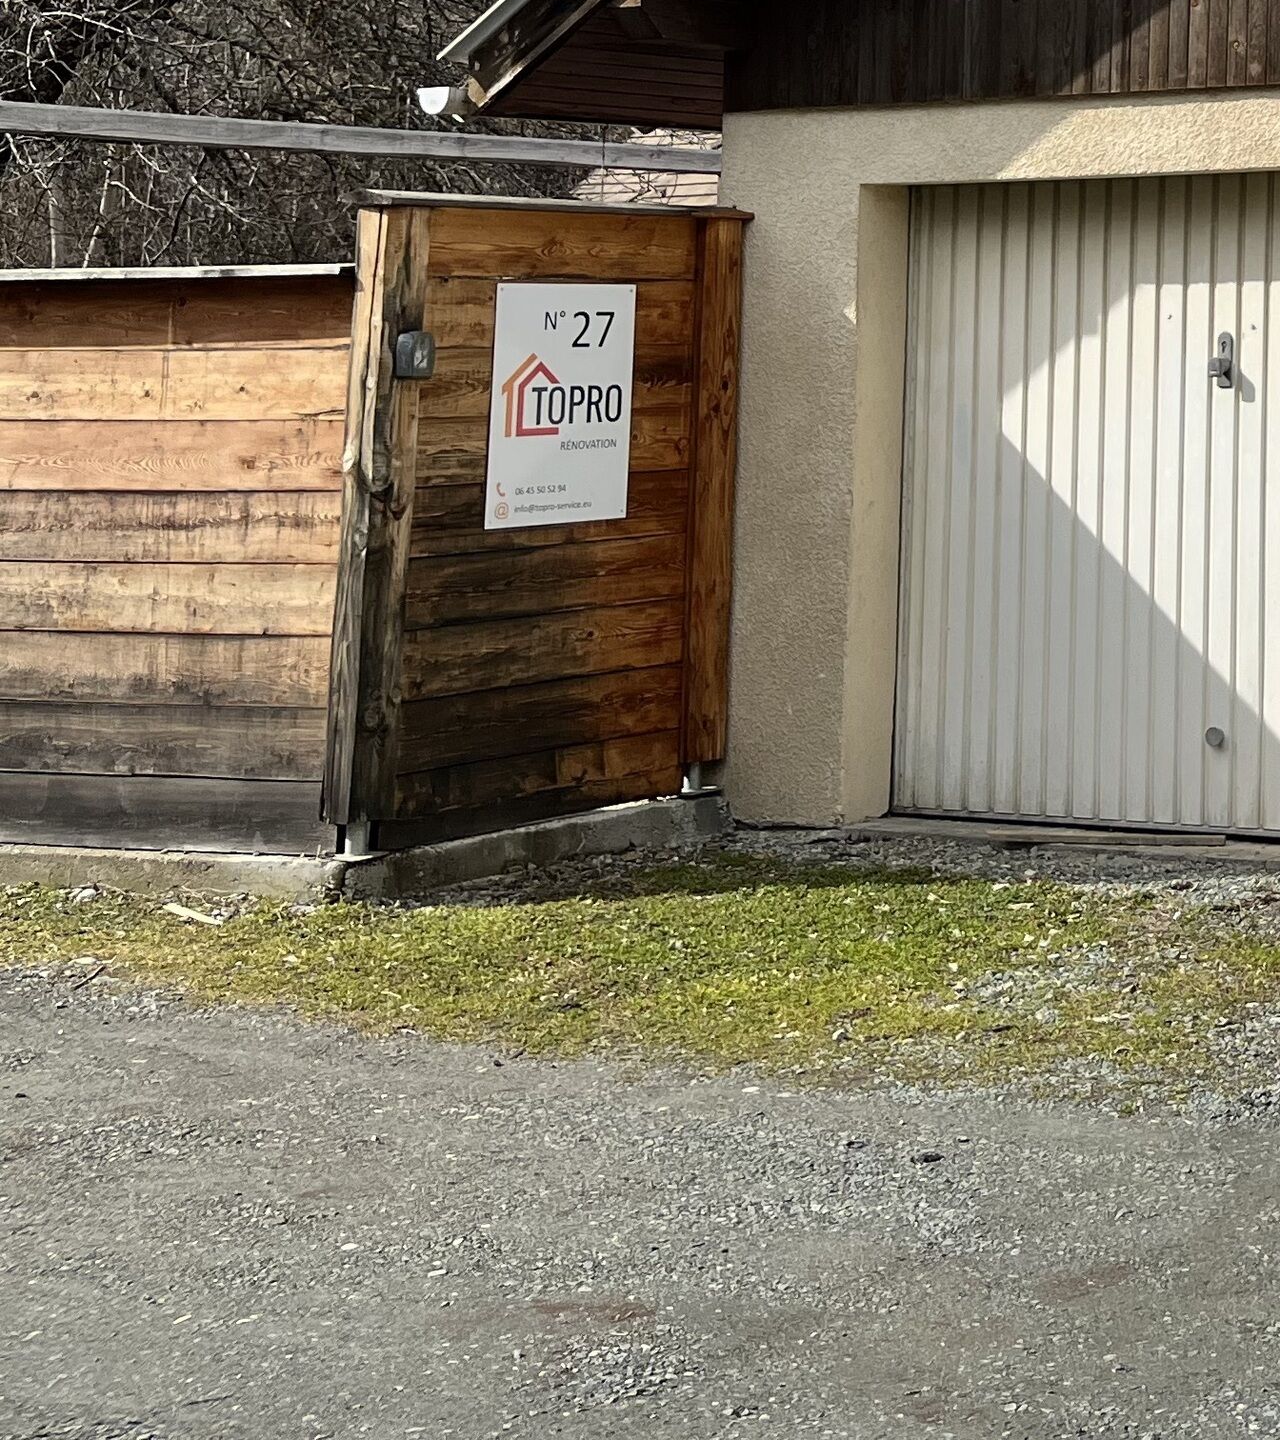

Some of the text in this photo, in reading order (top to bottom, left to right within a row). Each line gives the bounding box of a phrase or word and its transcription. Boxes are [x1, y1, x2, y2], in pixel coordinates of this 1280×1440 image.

[544, 310, 615, 348] N° 27
[532, 384, 622, 425] TOPRO
[560, 439, 618, 451] RÉNOVATION
[514, 487, 524, 496] 06
[536, 485, 546, 495] 50
[547, 484, 556, 494] 52
